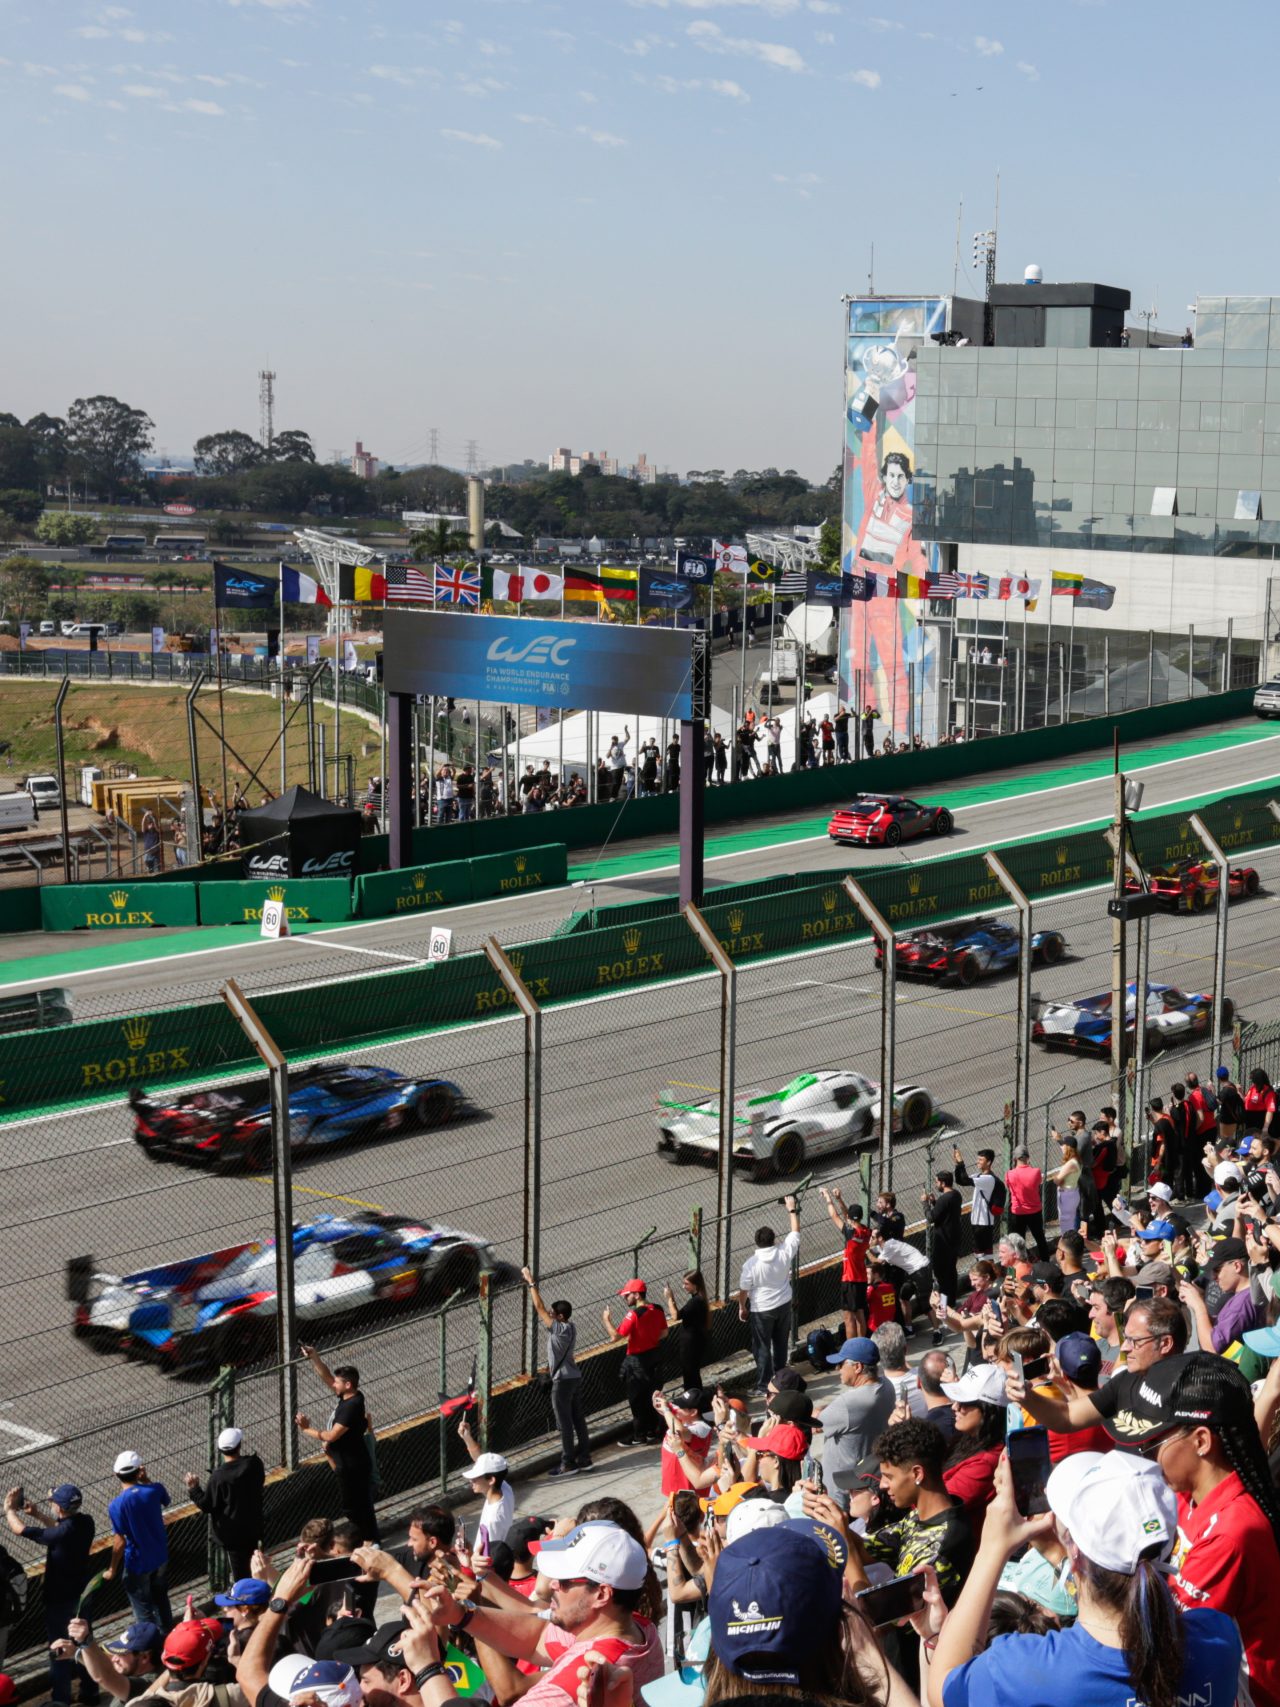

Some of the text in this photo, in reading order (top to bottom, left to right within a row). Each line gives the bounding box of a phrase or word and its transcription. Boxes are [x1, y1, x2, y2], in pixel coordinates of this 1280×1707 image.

[684, 562, 706, 576] FIA
[486, 635, 576, 666] WEC
[486, 675, 540, 686] CHAMPIONSHIP
[499, 668, 524, 676] WORLD
[526, 670, 570, 680] ENDURANCE
[249, 854, 289, 871] WEC
[301, 850, 355, 873] WEC
[500, 872, 543, 891] ROLEX
[1040, 866, 1081, 886] ROLEX
[396, 889, 444, 910] ROLEX
[888, 895, 938, 919] ROLEX
[86, 911, 155, 926] ROLEX
[266, 912, 277, 926] 60
[802, 912, 855, 939] ROLEX
[433, 940, 445, 953] 60
[704, 932, 765, 960] OLEX
[597, 952, 664, 984] ROLEX
[82, 1046, 189, 1087] ROLEX
[727, 1620, 782, 1636] MICHELIN
